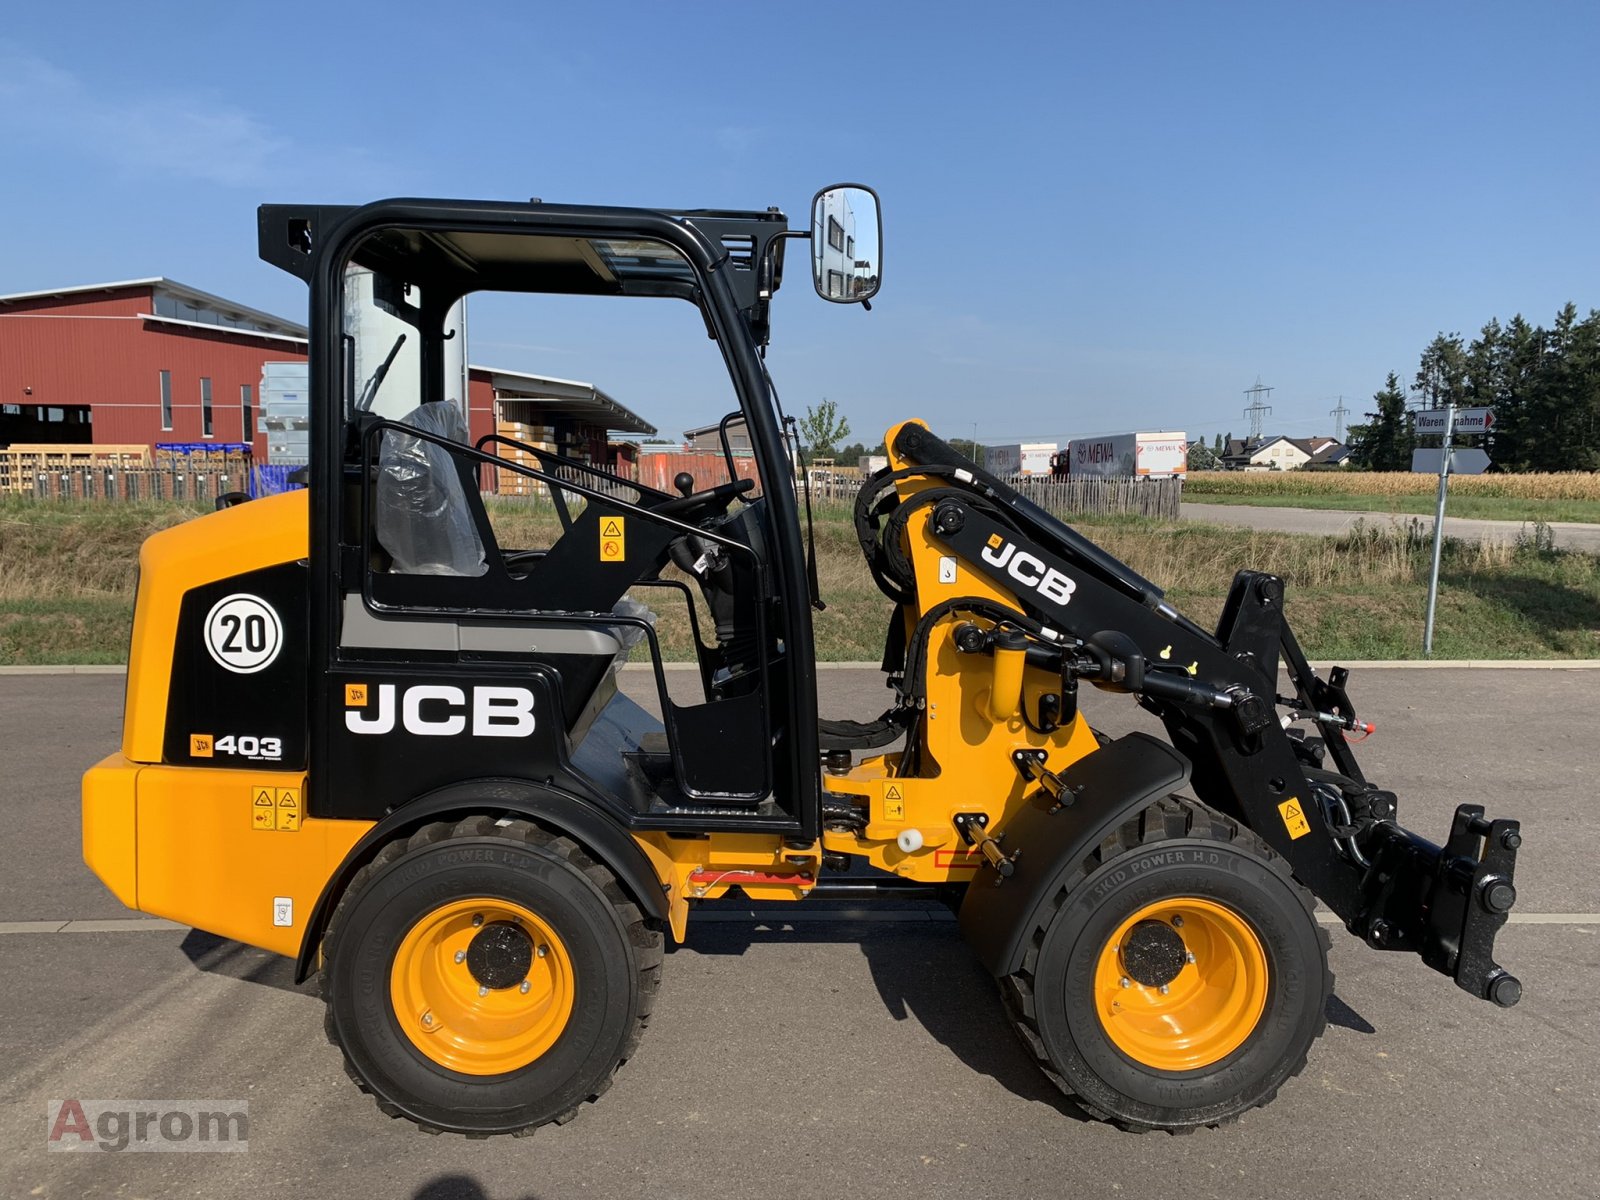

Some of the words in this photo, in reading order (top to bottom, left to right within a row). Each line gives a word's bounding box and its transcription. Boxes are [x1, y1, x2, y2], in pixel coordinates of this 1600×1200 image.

[1418, 416, 1484, 427] Warennahme
[1087, 442, 1114, 463] MEWA
[981, 542, 1077, 606] JCB
[220, 614, 267, 653] 20
[345, 684, 536, 738] JCB
[215, 735, 282, 757] 403
[437, 849, 494, 867] POWER
[1094, 871, 1126, 897] SKID
[1130, 852, 1185, 873] POWER
